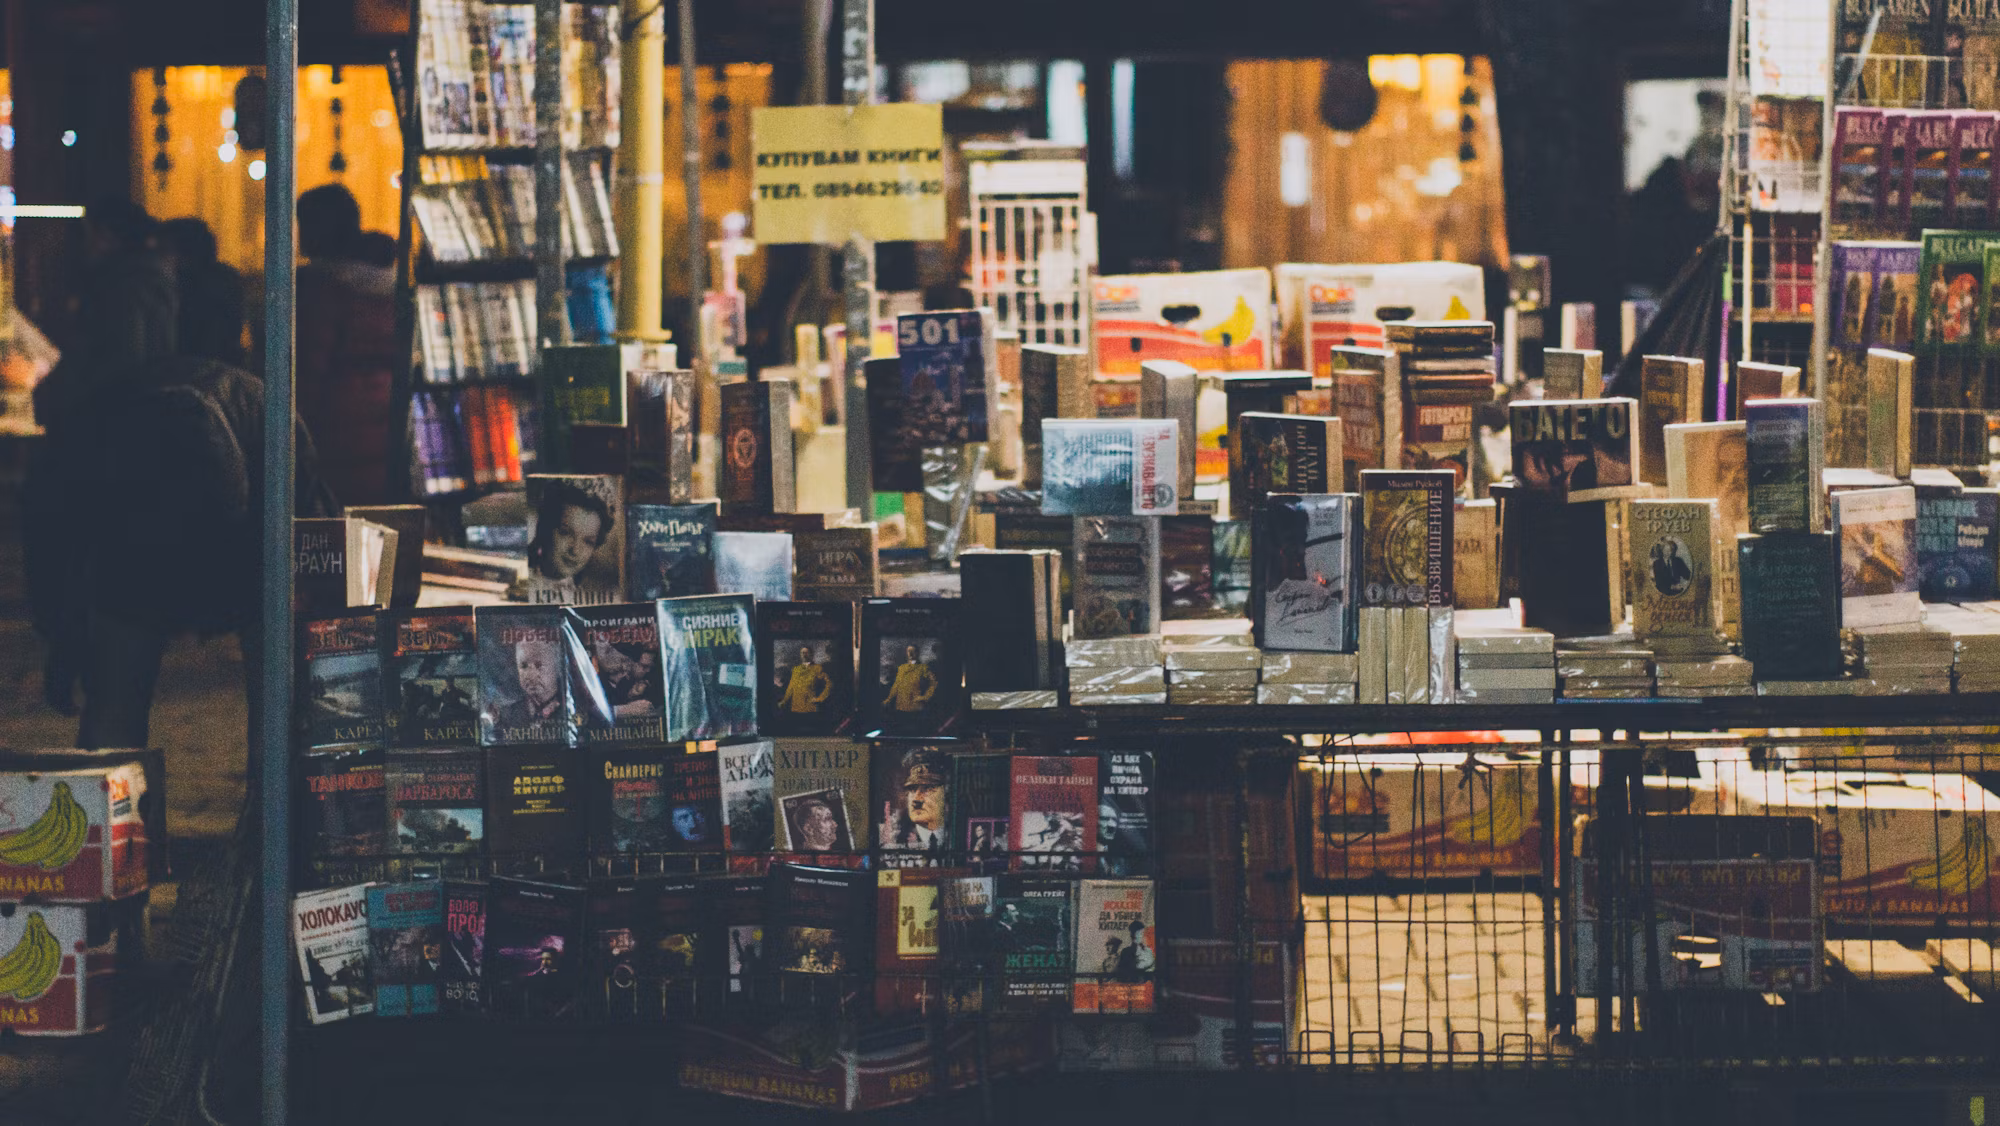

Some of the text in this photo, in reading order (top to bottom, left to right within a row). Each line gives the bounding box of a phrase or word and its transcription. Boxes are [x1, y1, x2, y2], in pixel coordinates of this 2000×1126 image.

[757, 149, 942, 167] КУПУВАМ КНИГИ
[759, 182, 807, 199] ТЕЛ.
[900, 318, 961, 345] 501
[1142, 431, 1156, 510] АЗУЗНАВАНЕТО
[1634, 508, 1701, 520] СТЕФАН
[1646, 519, 1692, 533] ГРУЕВ
[301, 533, 328, 549] ДАН
[1428, 490, 1443, 604] ВЪЗВИШЕНИЕ
[583, 616, 656, 629] ПРОИГРАНИ
[682, 615, 738, 630] СИЯНИЕ
[780, 750, 860, 769] ХИТЛЕР
[513, 775, 565, 786] АДОЛФ
[1016, 775, 1056, 785] ВЕЛИКИ
[0, 875, 65, 892] NANAS
[1100, 911, 1112, 922] ДА
